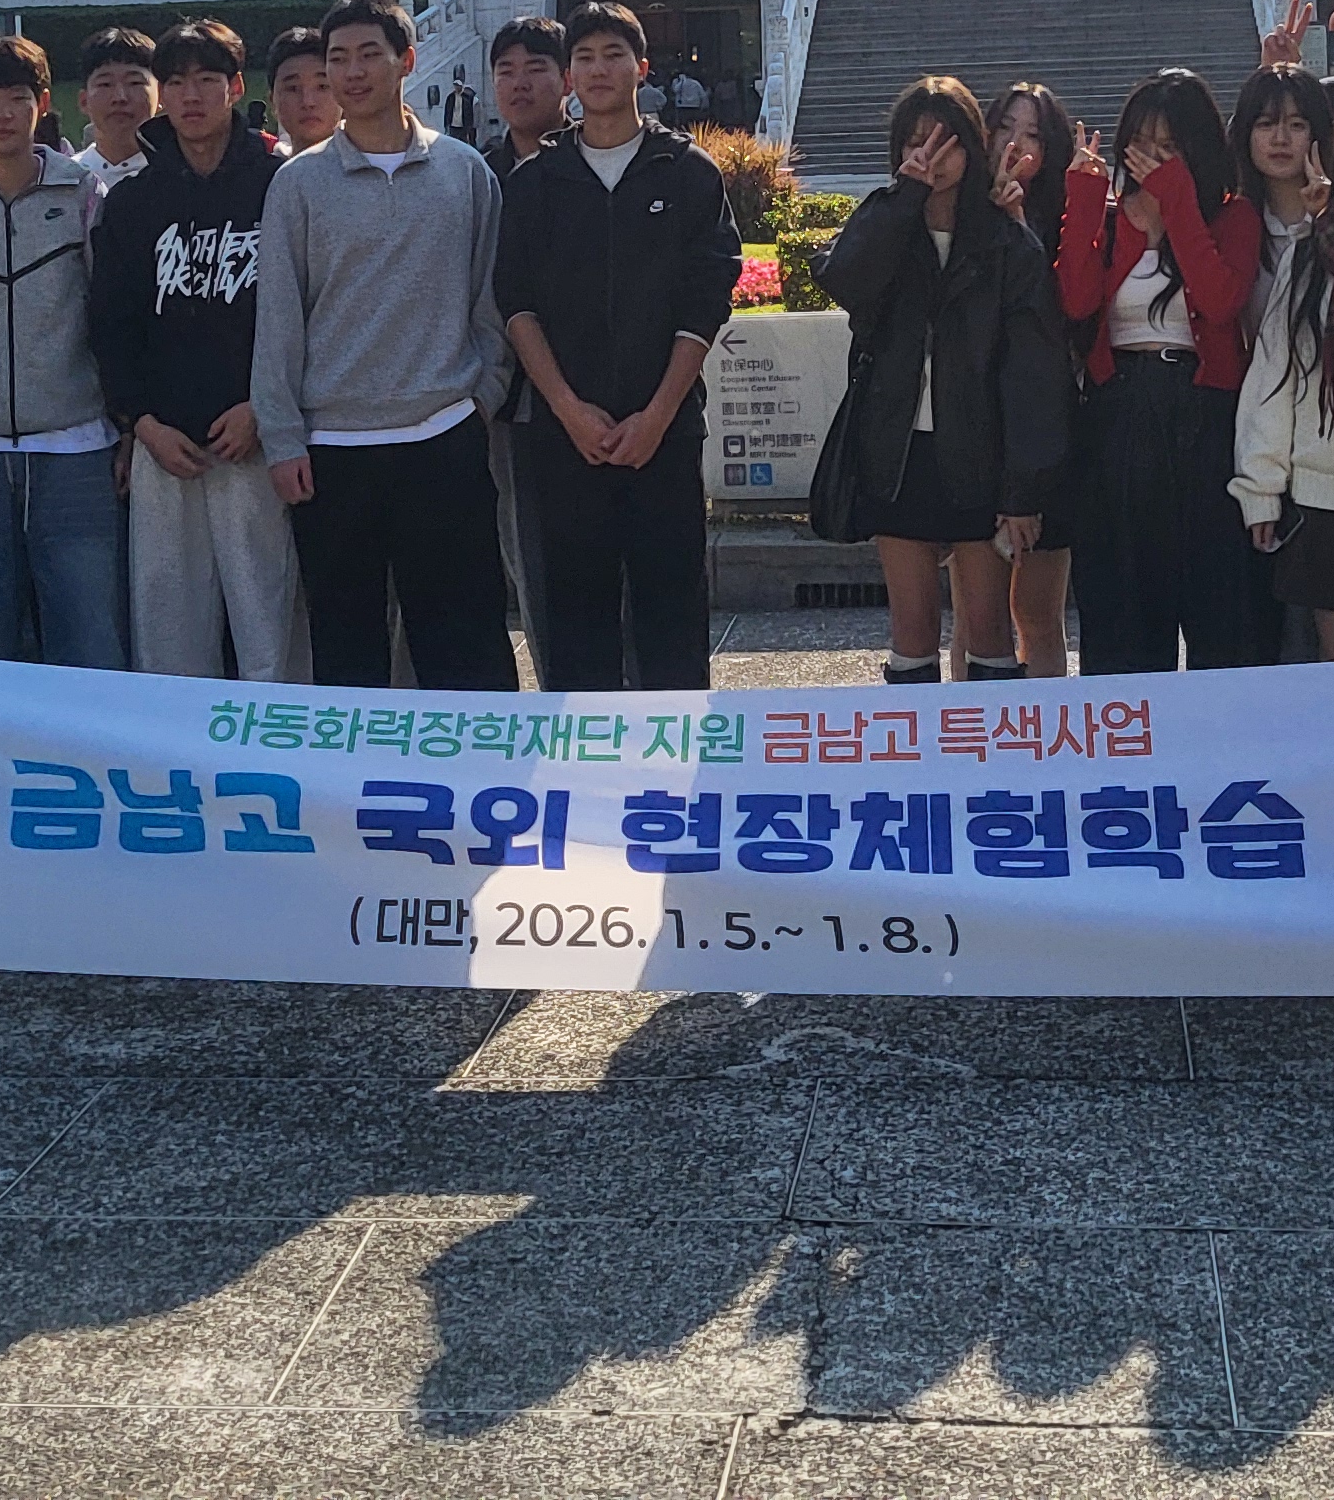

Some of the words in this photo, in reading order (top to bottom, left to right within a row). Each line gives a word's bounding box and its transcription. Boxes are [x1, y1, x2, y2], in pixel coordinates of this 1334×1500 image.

[720, 358, 774, 373] 教保中心
[208, 700, 629, 762] 하동화력장학재단
[642, 713, 745, 763] 지원
[763, 711, 922, 764] 금남고
[938, 699, 1153, 763] 특색사업
[10, 759, 316, 854] 금남고
[356, 780, 571, 871] 국외
[620, 780, 1306, 880] 현장체험학습
